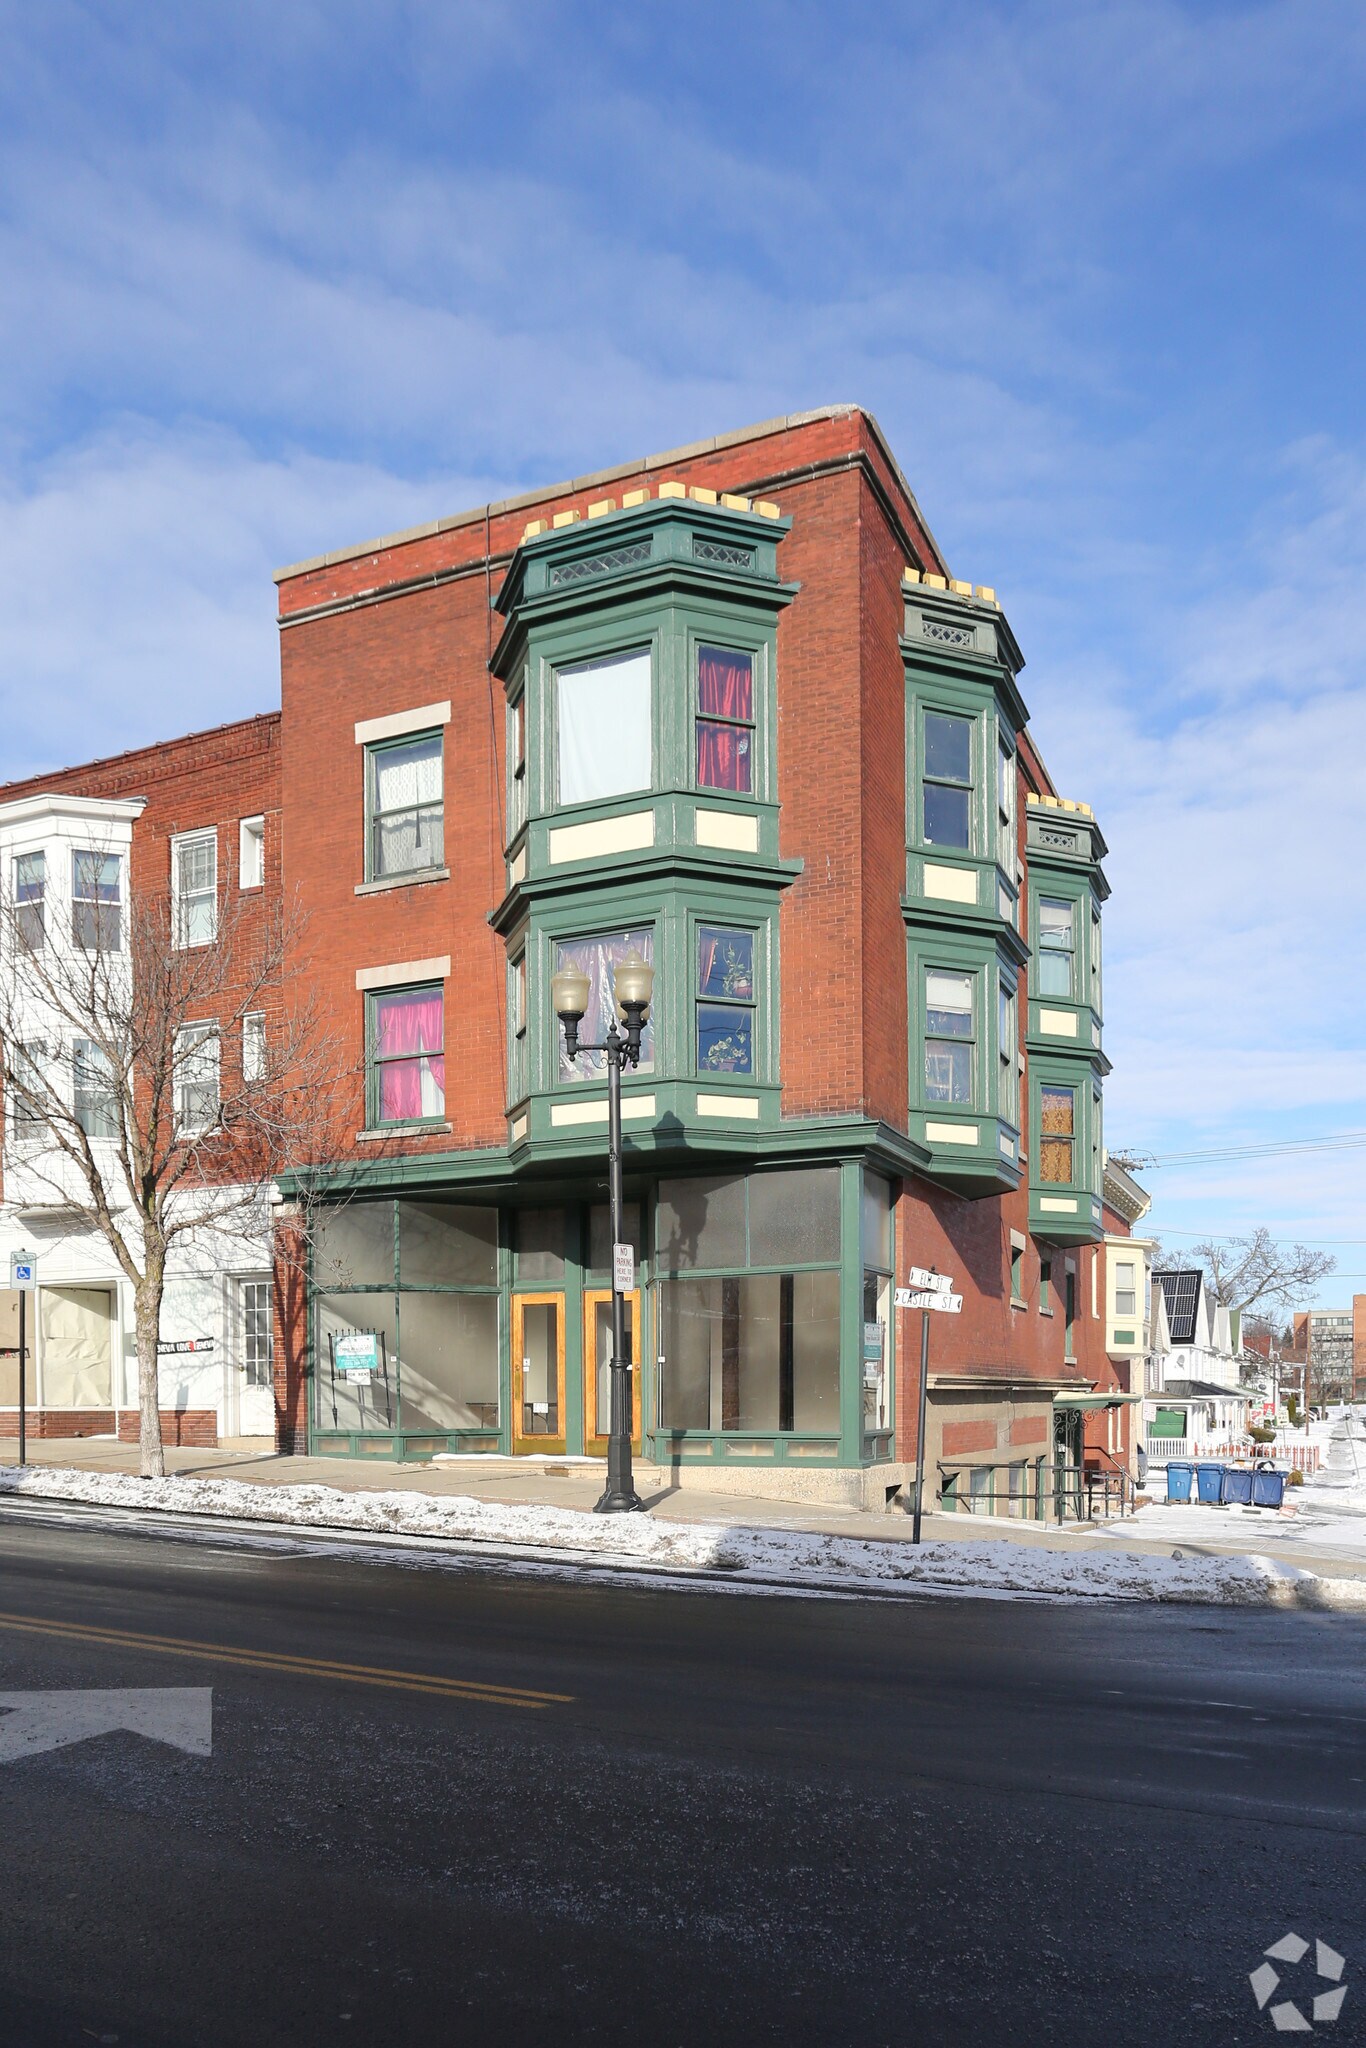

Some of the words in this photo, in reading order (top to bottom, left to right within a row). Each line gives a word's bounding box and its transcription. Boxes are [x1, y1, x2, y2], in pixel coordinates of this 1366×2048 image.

[620, 1248, 628, 1257] NO
[616, 1257, 632, 1268] PARKING
[920, 1272, 933, 1288] ELM
[936, 1277, 944, 1291] ST
[901, 1291, 933, 1308] CASTLE
[941, 1296, 953, 1309] ST
